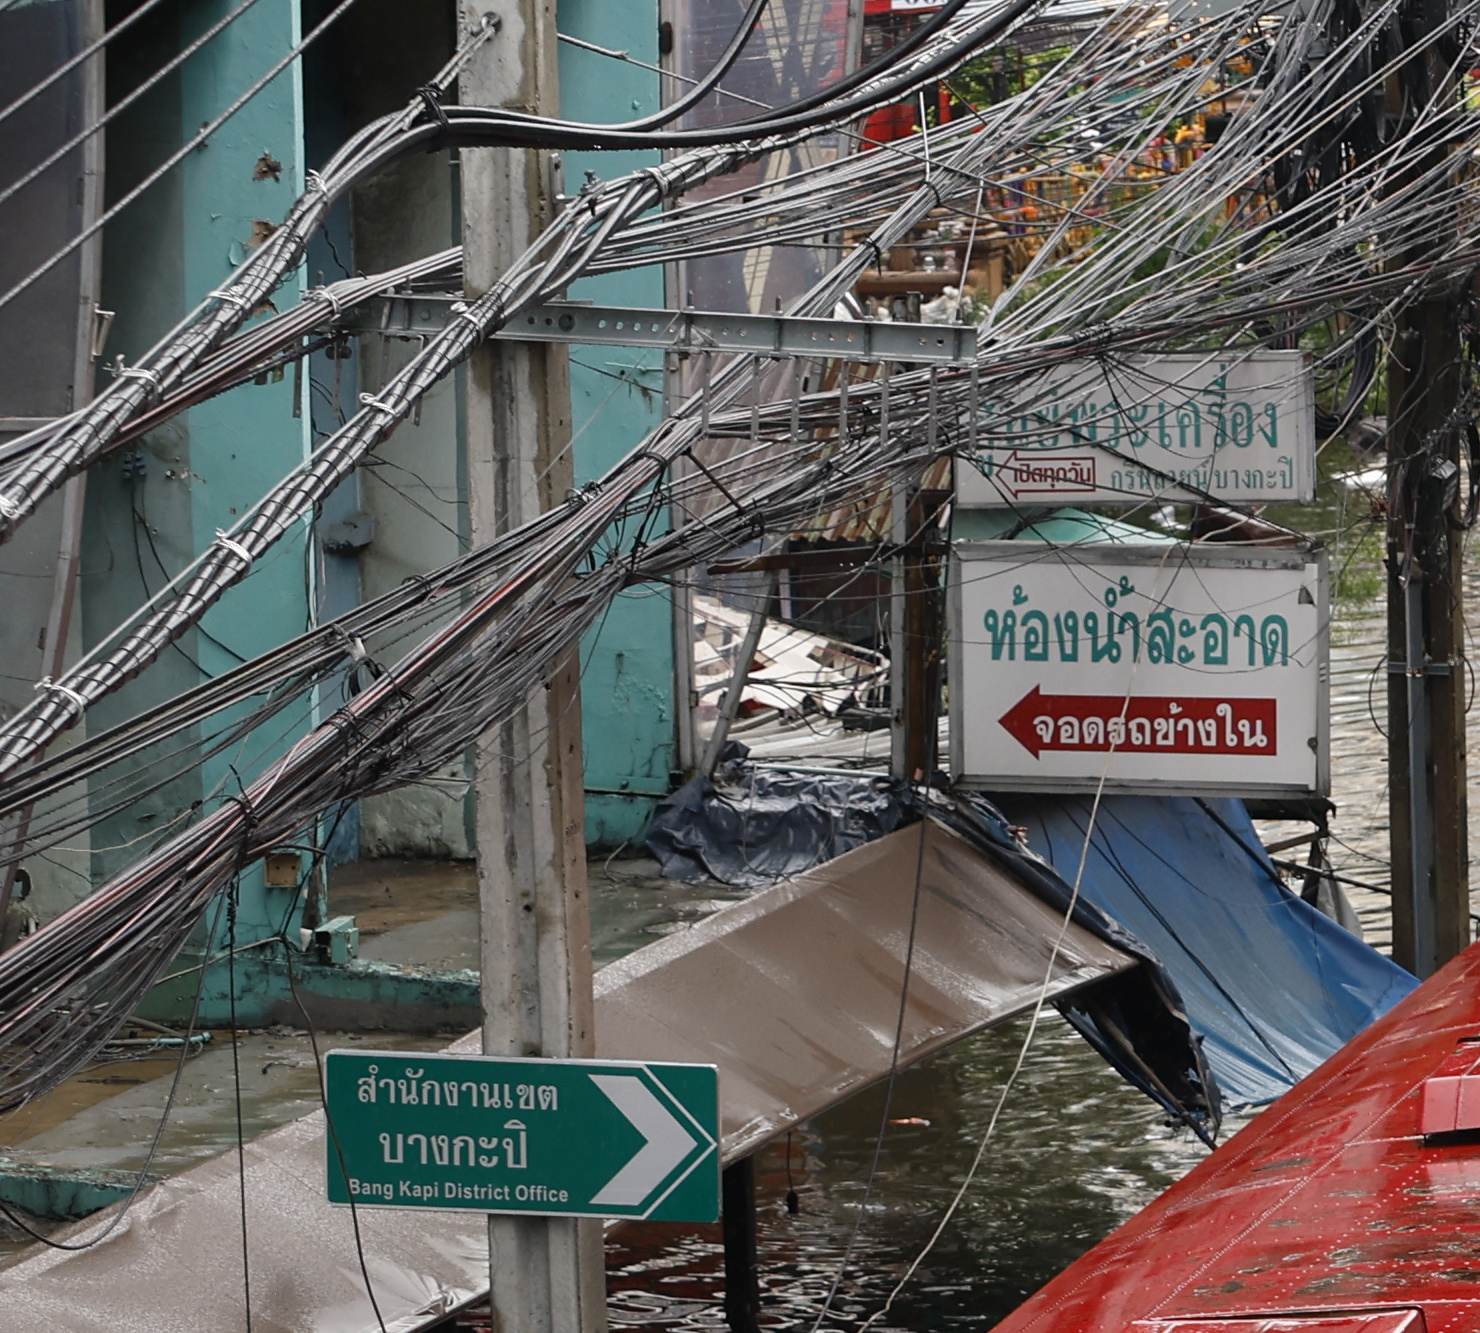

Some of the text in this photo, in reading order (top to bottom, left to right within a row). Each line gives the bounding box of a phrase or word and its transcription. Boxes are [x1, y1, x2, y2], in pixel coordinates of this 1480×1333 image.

[1013, 461, 1092, 488] เปิดทุกวัน
[984, 576, 1289, 667] ห้องน้ำสะอาด
[1033, 702, 1268, 747] จอดรถข้างใน
[357, 1064, 558, 1111] สำนักงานเขต
[379, 1119, 527, 1168] บางกะปิ
[348, 1178, 569, 1202] Bang Kapi District Office
